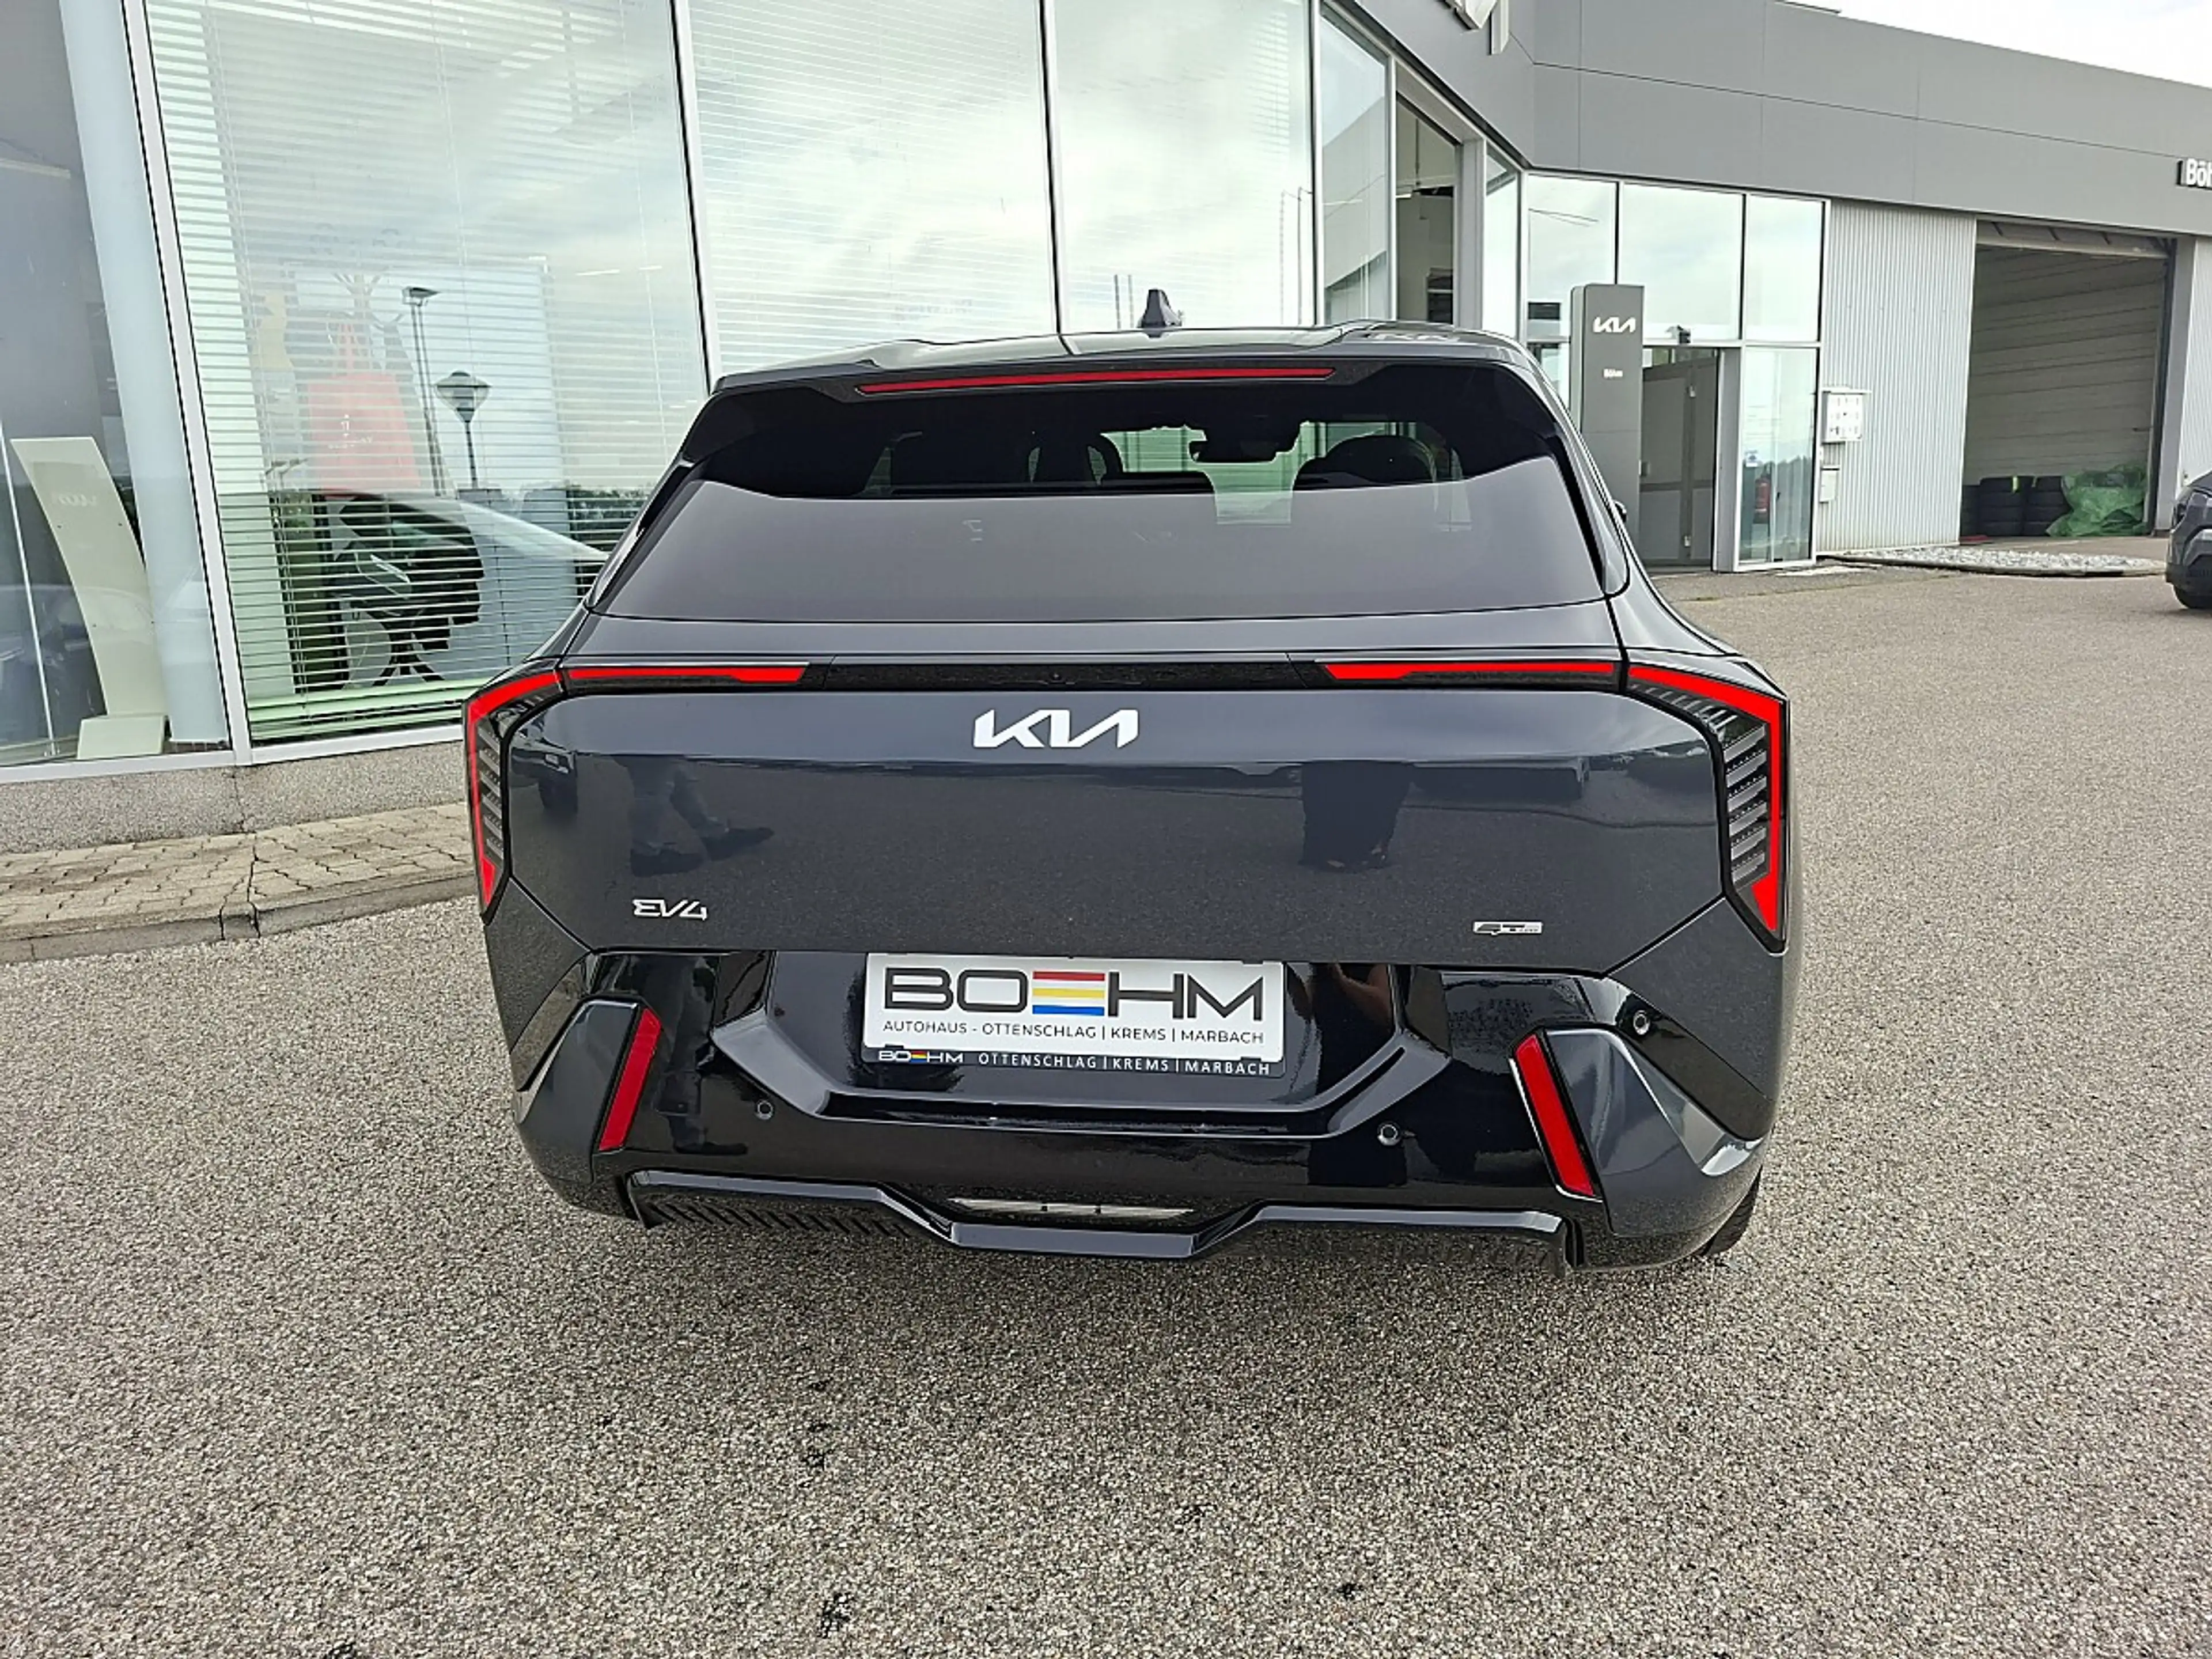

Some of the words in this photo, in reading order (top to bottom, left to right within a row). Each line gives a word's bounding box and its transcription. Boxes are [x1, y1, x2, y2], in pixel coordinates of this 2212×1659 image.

[1593, 317, 1636, 332] KIA
[974, 709, 1138, 748] KIA
[632, 899, 707, 921] EV4
[884, 967, 1264, 1021] BOEHM
[882, 1021, 968, 1034] AUTOHAUS
[982, 1022, 1096, 1039] OTTENSCHLAG
[1111, 1027, 1166, 1041] KREMS
[1181, 1029, 1264, 1044] MARBACH
[878, 1050, 964, 1064] BOEHM
[978, 1052, 1096, 1069] OTTENSCHLAG
[1112, 1058, 1168, 1071] KREMS
[1185, 1060, 1270, 1075] MARBACH
